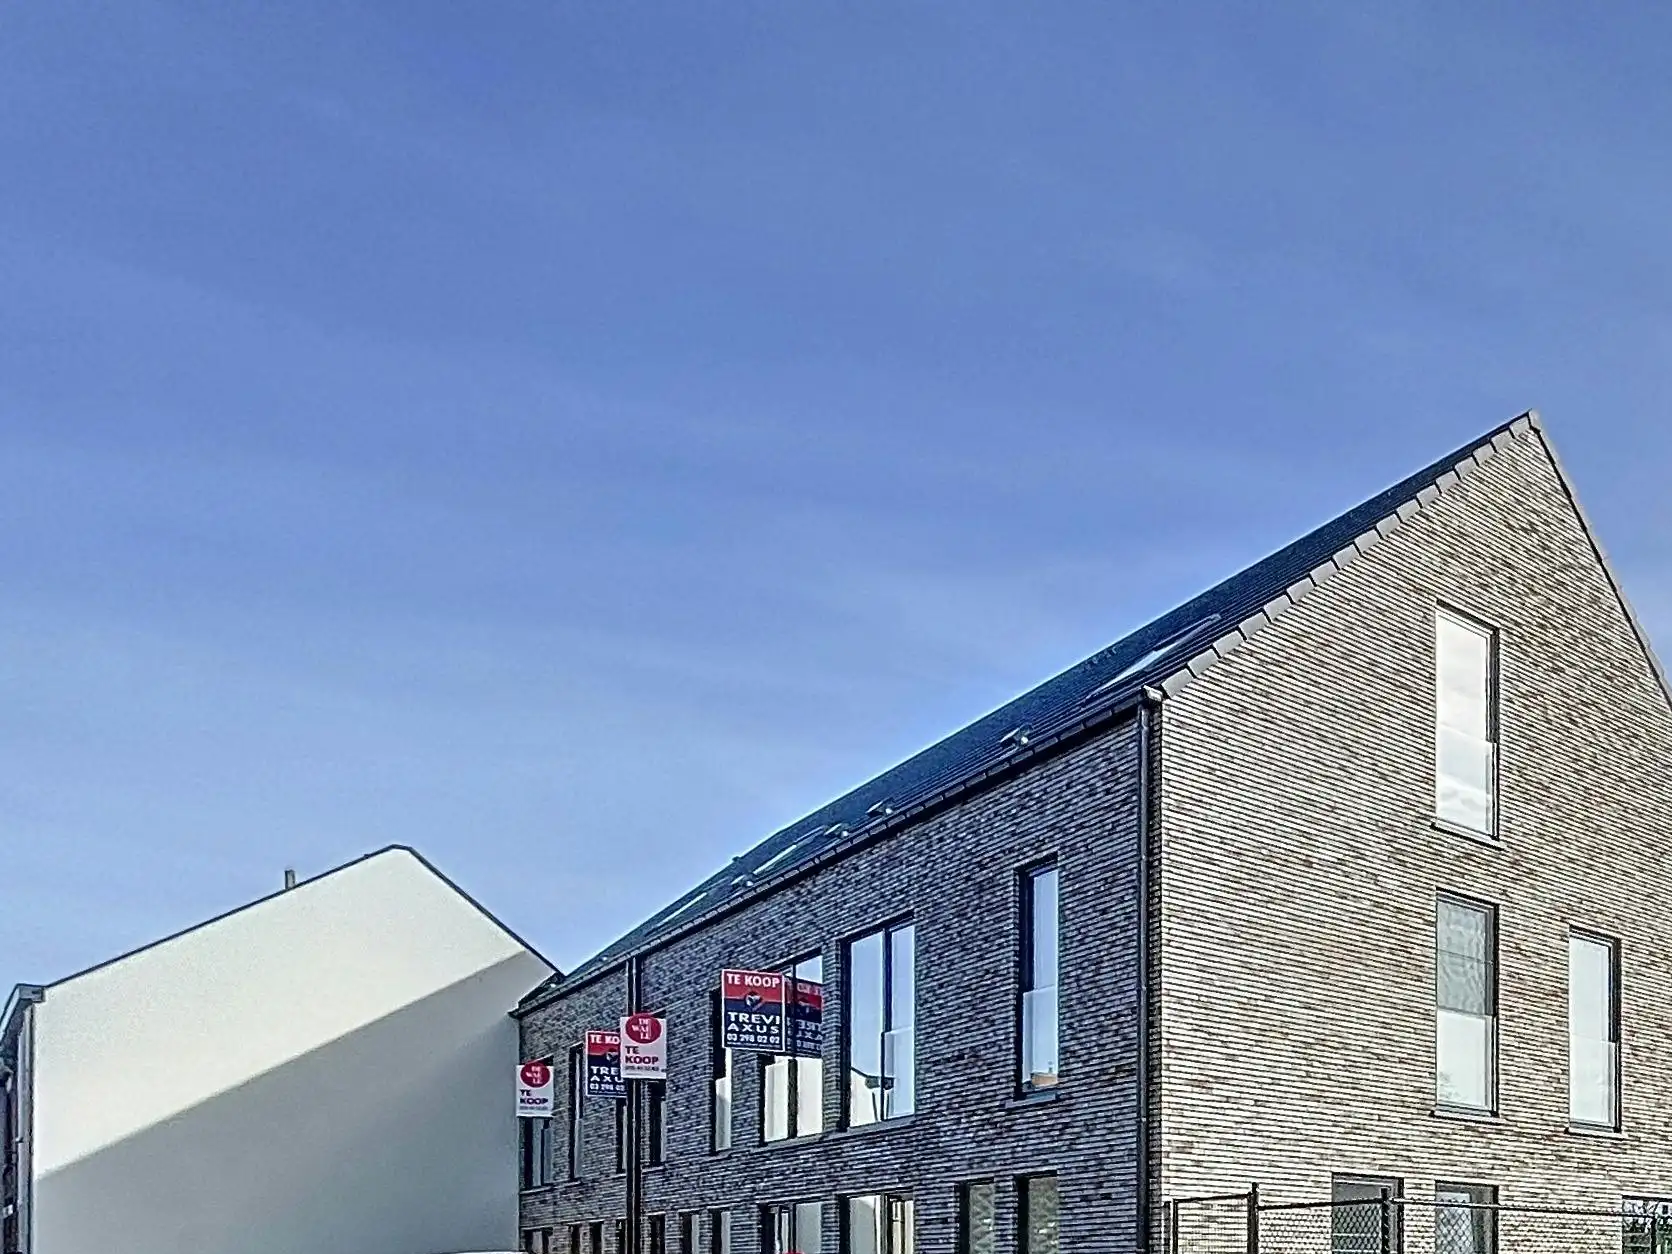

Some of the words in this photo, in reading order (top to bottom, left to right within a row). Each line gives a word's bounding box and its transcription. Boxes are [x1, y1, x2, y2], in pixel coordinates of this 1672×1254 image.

[726, 973, 740, 985] TE
[744, 975, 780, 988] KOOP
[727, 1012, 780, 1025] TREVI
[727, 1023, 780, 1034] AXUS
[605, 1035, 620, 1044] KO
[625, 1046, 639, 1054] TE
[625, 1056, 659, 1065] KOOP
[590, 1066, 619, 1075] TRE
[590, 1075, 624, 1083] AXU
